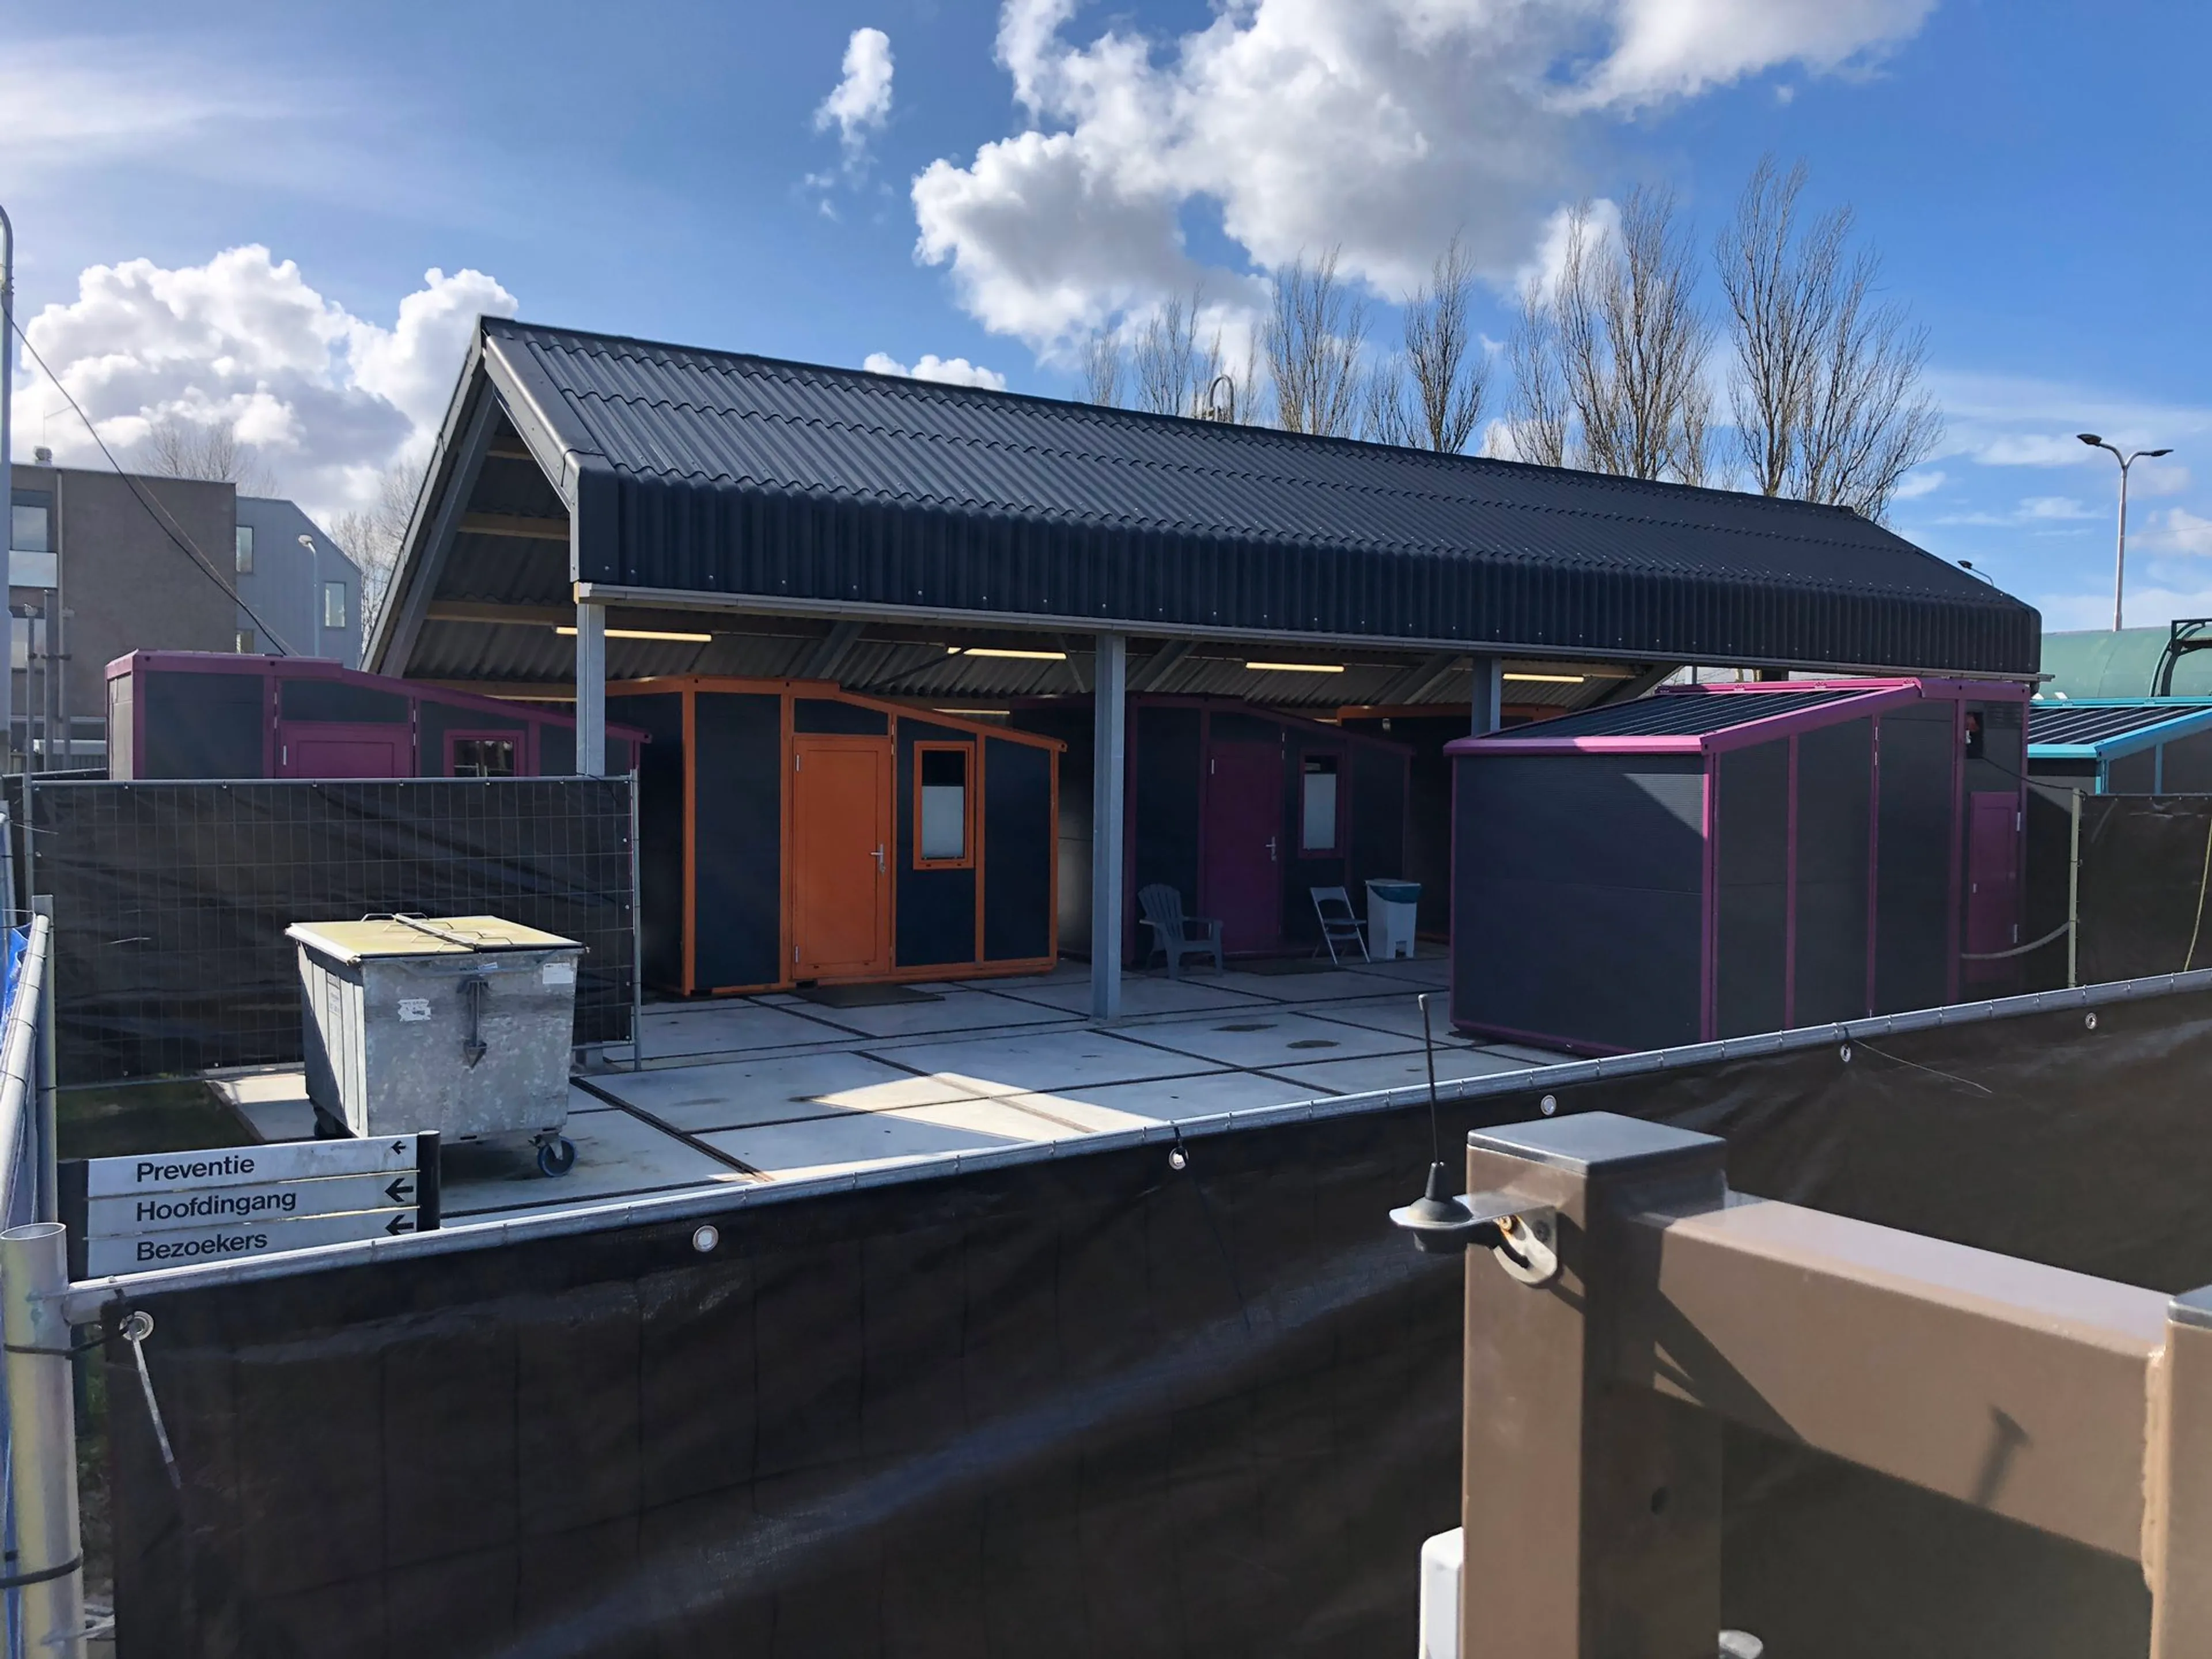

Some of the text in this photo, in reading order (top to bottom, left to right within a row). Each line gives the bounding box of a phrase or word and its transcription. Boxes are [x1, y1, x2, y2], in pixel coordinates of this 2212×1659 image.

[137, 1155, 255, 1183] Preventie
[137, 1192, 297, 1222] Hoofdingang
[137, 1233, 268, 1262] Bezoekers
